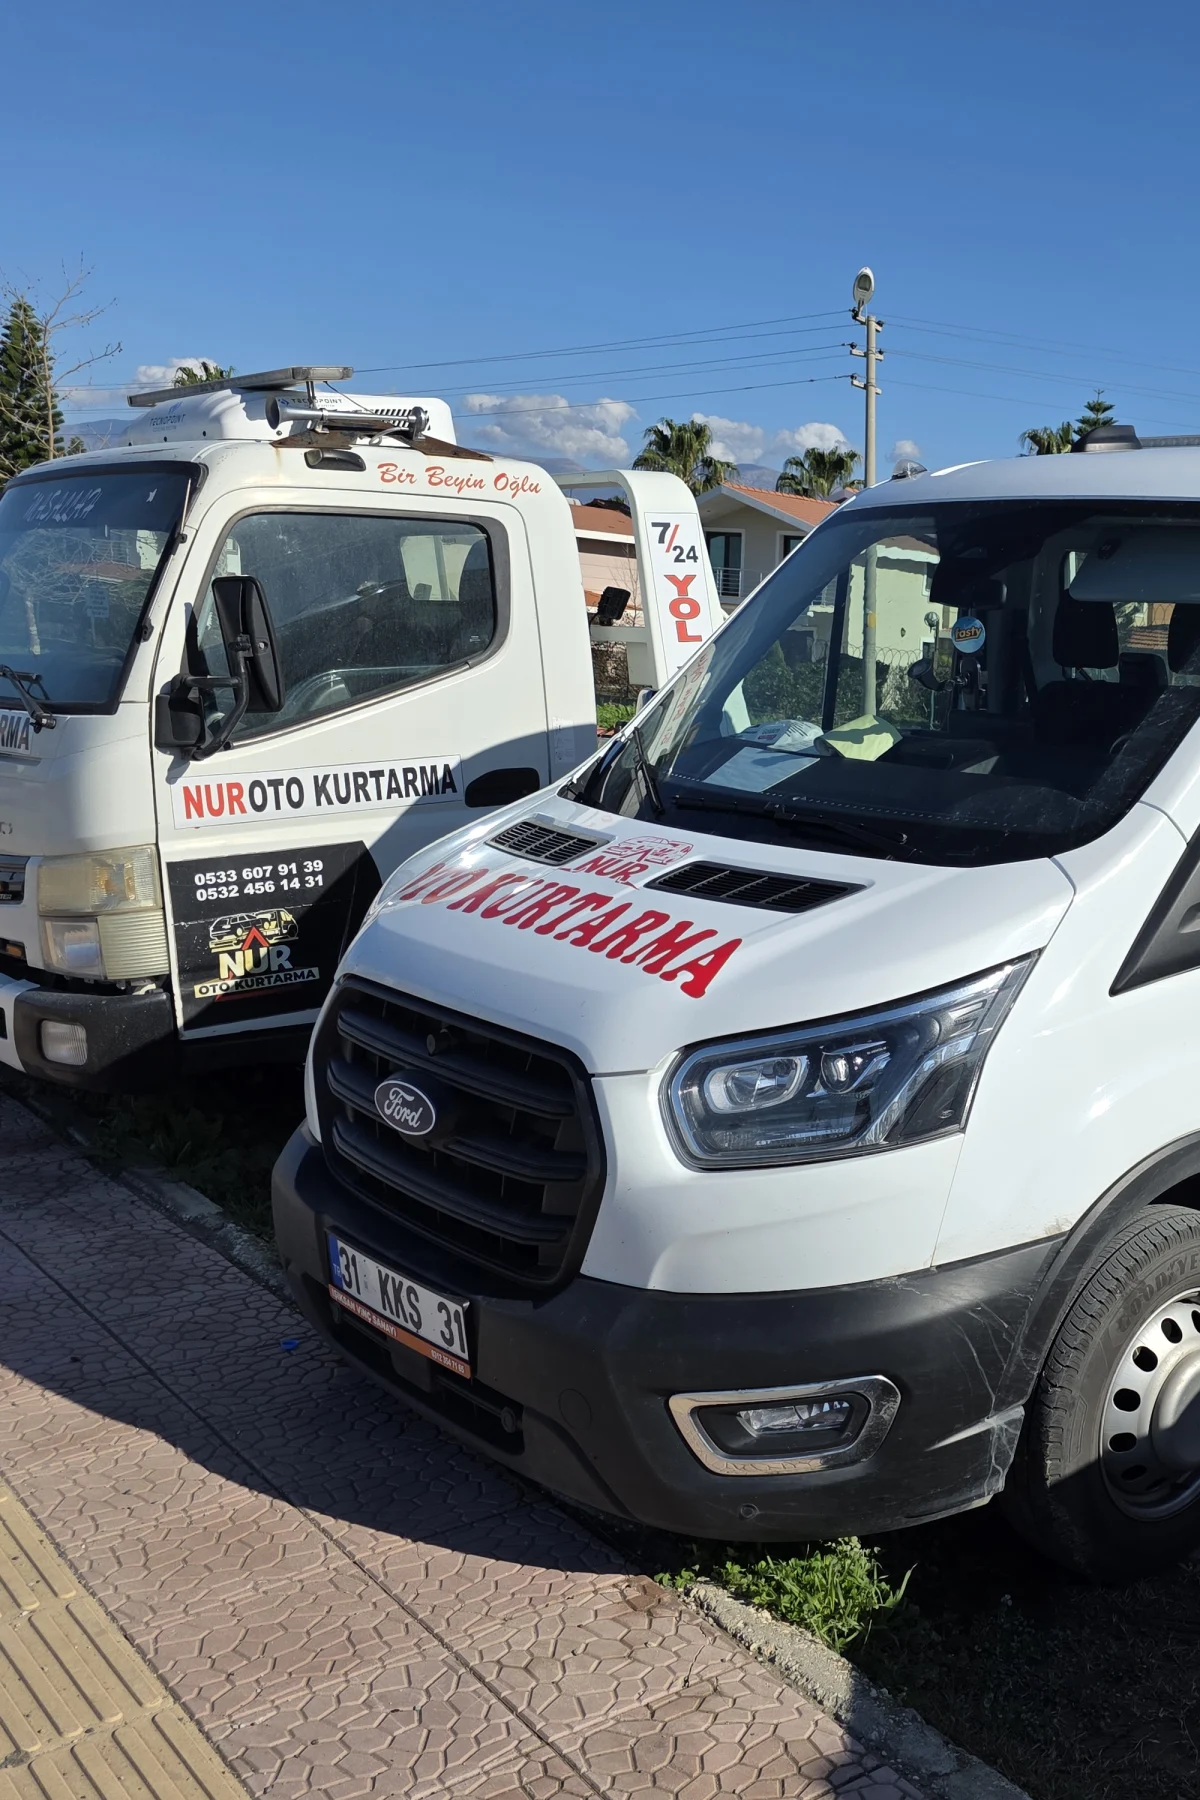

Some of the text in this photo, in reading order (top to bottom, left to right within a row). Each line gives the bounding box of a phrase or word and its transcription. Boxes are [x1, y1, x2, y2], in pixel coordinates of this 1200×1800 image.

[377, 463, 541, 499] Bir Beyin Oğlu
[664, 575, 703, 642] YOL
[182, 763, 458, 820] NUR OTO KURTARMA
[194, 860, 324, 886] 0533 607 91 39
[573, 855, 650, 881] NUR
[196, 874, 324, 902] 0532 456 14 31
[446, 873, 743, 999] KURTARMA
[219, 944, 293, 980] NUR
[198, 969, 316, 995] OTO KURTARMA
[383, 1087, 423, 1128] Ford
[339, 1246, 466, 1354] 31 KKS 31
